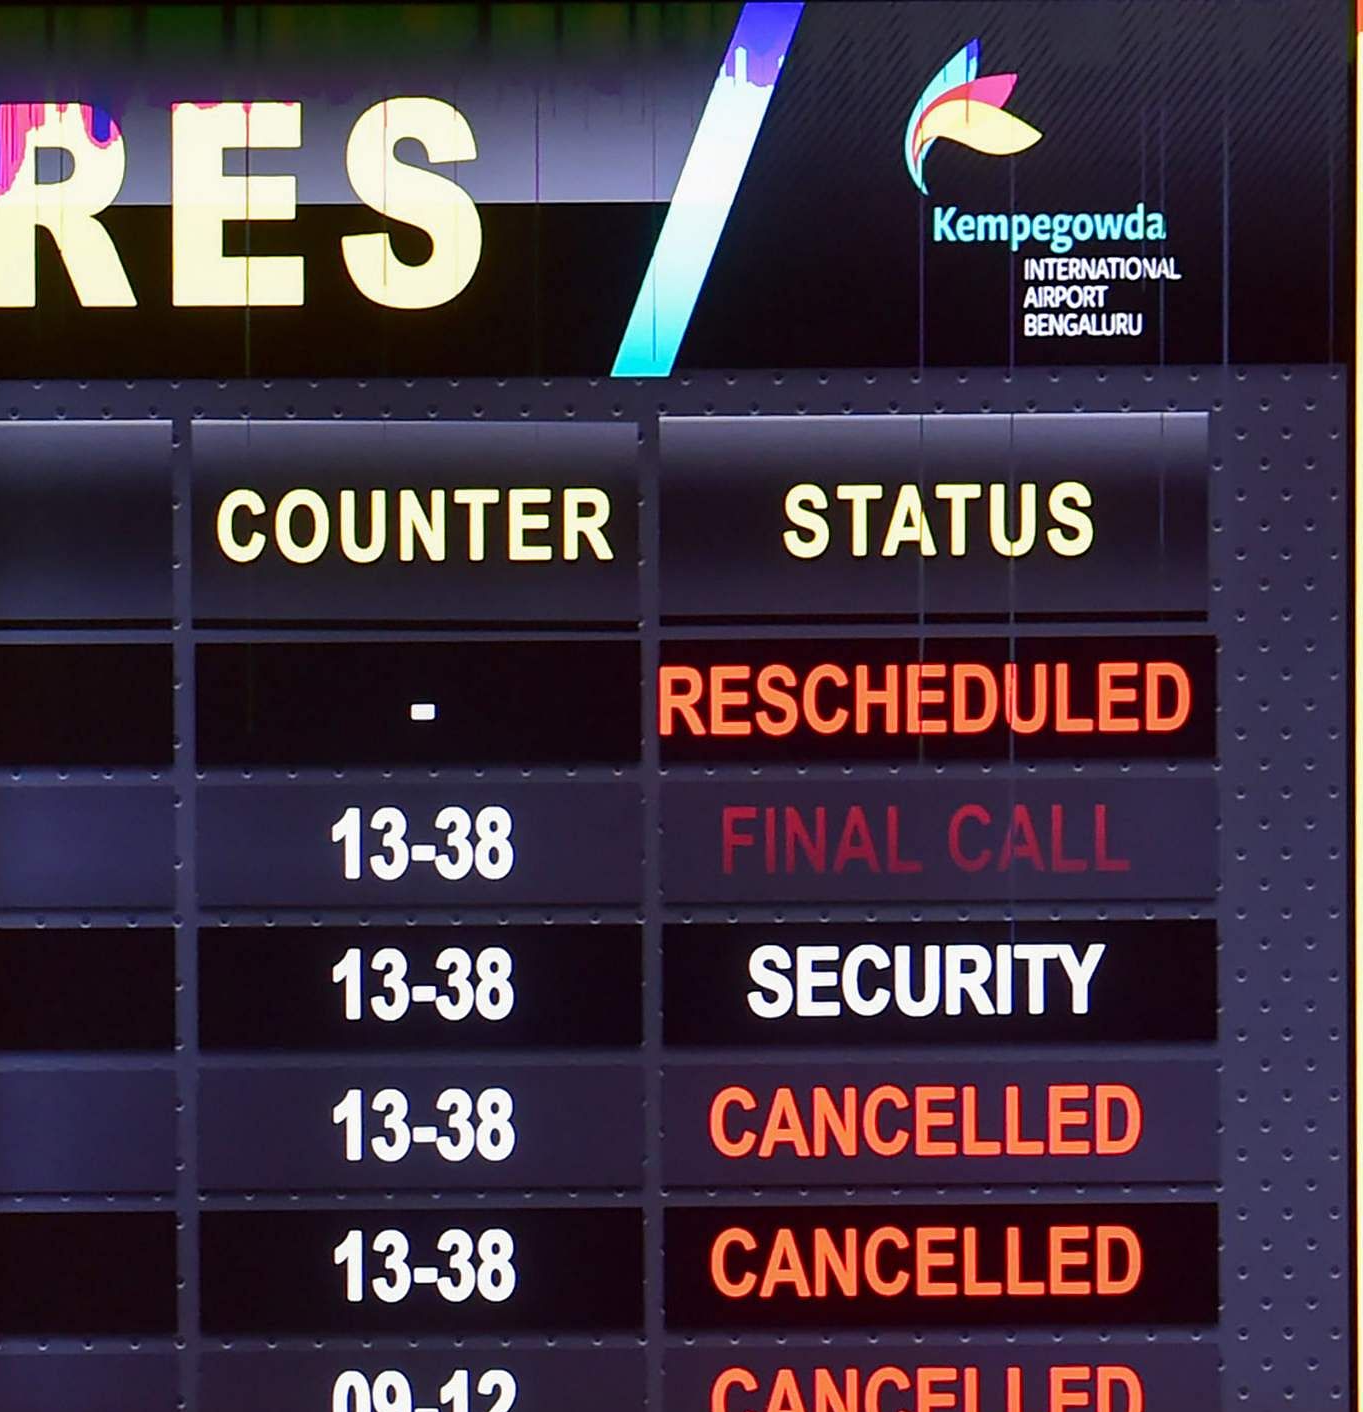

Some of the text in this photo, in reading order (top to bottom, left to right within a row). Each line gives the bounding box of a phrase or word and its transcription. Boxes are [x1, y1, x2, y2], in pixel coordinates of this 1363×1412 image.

[933, 202, 1167, 254] Kempegowda
[1023, 284, 1109, 309] AIRPORT
[1024, 256, 1182, 281] INTERNATIONAL
[1023, 312, 1143, 337] BENGALURU
[217, 488, 614, 564] COUNTER
[783, 481, 1094, 559] STATUS
[658, 661, 1192, 737] RESCHEDULED
[331, 806, 514, 881] 13-38
[722, 803, 1129, 873] FINAL CALL
[332, 947, 514, 1022] 13-38
[747, 943, 1106, 1019] SECURITY
[333, 1087, 515, 1162] 13-38
[709, 1084, 1142, 1158] CANCELLED
[334, 1228, 516, 1303] 13-38
[710, 1225, 1143, 1299] CANCELLED
